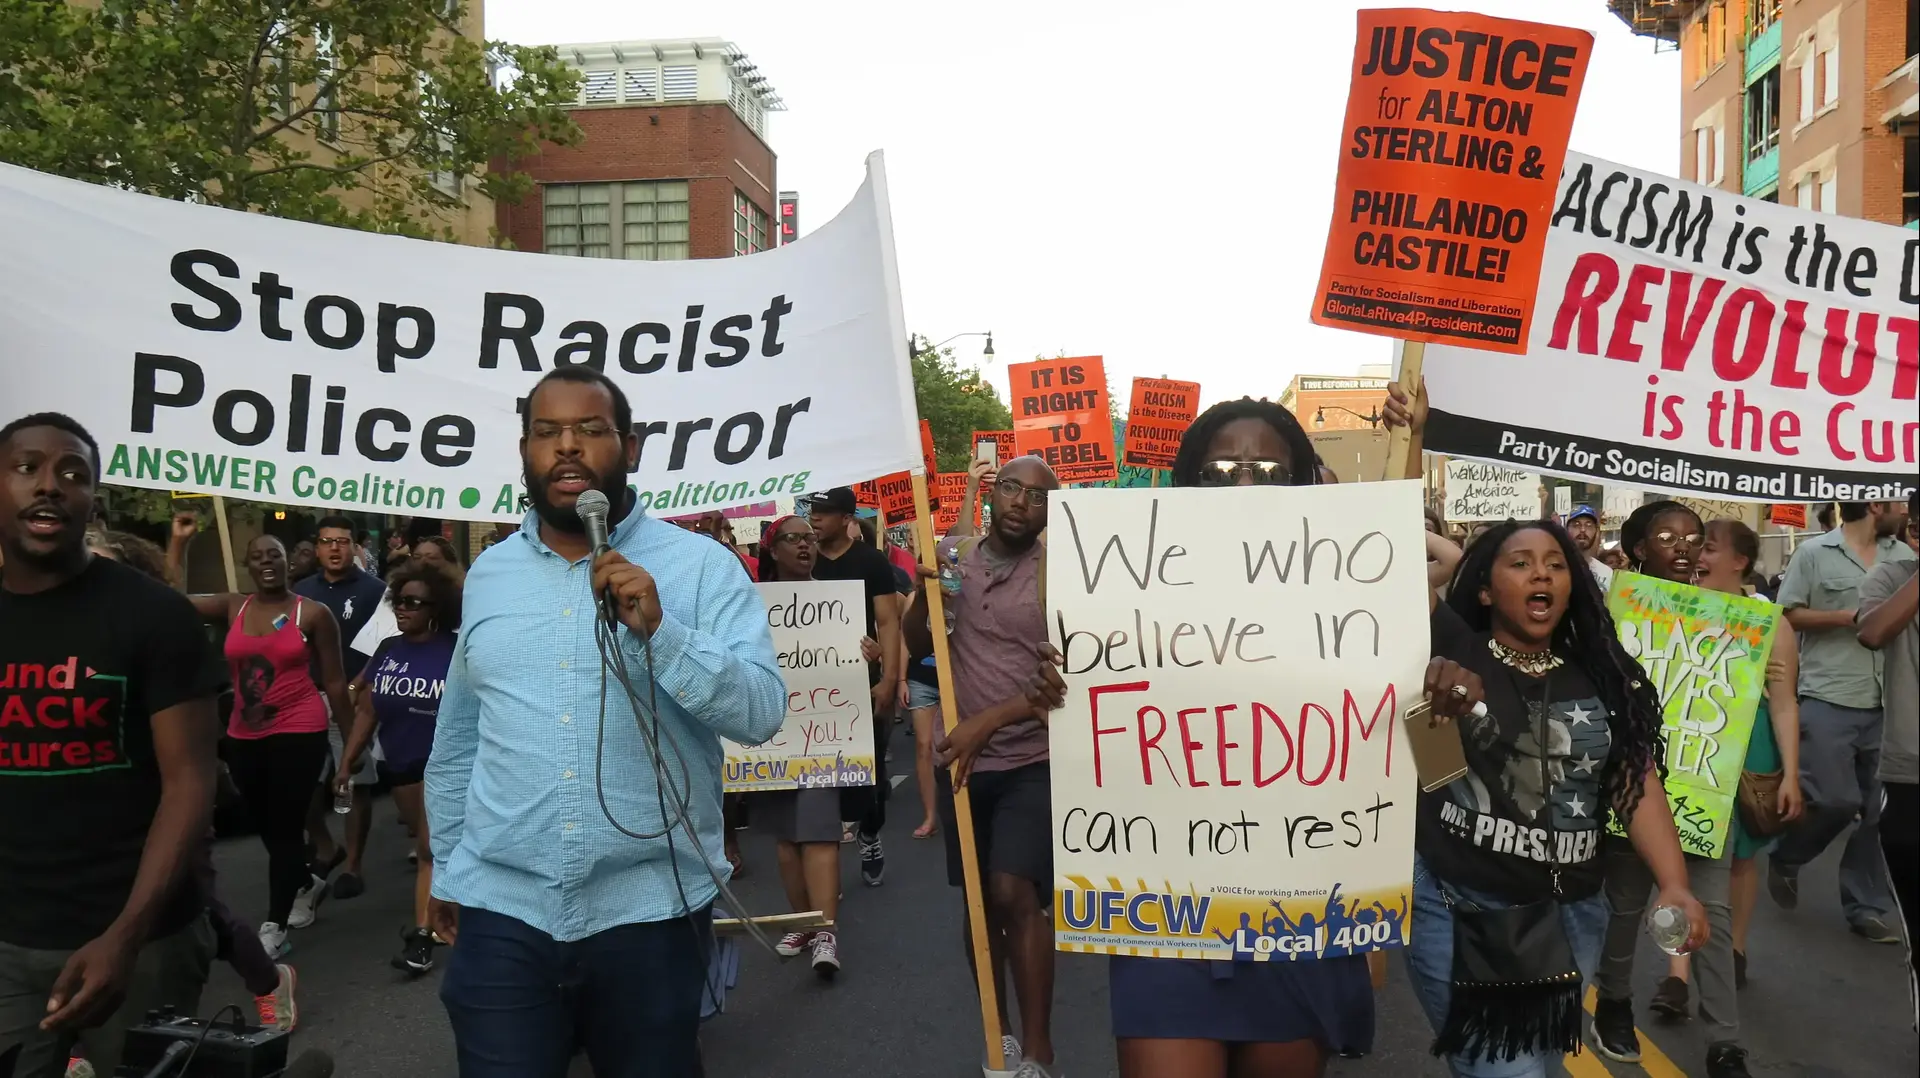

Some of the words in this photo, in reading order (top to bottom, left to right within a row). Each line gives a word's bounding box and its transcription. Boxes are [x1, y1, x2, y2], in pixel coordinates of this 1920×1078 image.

[1361, 26, 1577, 97] JUSTICE
[1378, 87, 1411, 119] for
[1416, 89, 1533, 136] ALTON
[1351, 126, 1514, 174] STERLING
[1518, 145, 1545, 180] &
[1351, 190, 1528, 244] PHILANDO
[1552, 162, 1713, 263] ACISM
[1722, 204, 1769, 275] is
[1785, 223, 1877, 297] the
[1354, 232, 1510, 283] CASTILE!
[170, 249, 435, 373] Stop
[478, 292, 793, 374] Racist
[1326, 300, 1516, 338] GloriaLaRiva4President.com
[1331, 281, 1357, 296] Party
[1359, 285, 1374, 297] for
[1376, 287, 1435, 305] Socialism
[1437, 296, 1459, 308] and
[1460, 297, 1521, 316] Liberation
[1031, 368, 1054, 389] IT
[1060, 365, 1085, 385] IS
[1144, 391, 1186, 408] RACISM
[130, 352, 476, 468] Police
[516, 397, 811, 474] rror
[1022, 390, 1098, 416] RIGHT
[1133, 406, 1139, 415] is
[1142, 407, 1156, 417] the
[1642, 374, 1685, 441] is
[1707, 388, 1800, 456] the
[1048, 422, 1081, 443] TO
[1136, 441, 1142, 450] is
[1145, 441, 1159, 452] the
[107, 443, 276, 495] ANSWER
[292, 465, 445, 509] Coalition
[938, 476, 968, 487] USTIC
[1499, 430, 1560, 466] Party
[1565, 442, 1601, 470] for
[1604, 449, 1729, 490] Socialism
[1735, 472, 1786, 496] and
[890, 499, 896, 508] is
[899, 495, 912, 506] the
[1061, 498, 1194, 595] We
[1242, 515, 1394, 586] who
[768, 592, 850, 629] edom,
[776, 641, 860, 669] edom...
[1055, 608, 1277, 674] believe
[1314, 608, 1379, 660] in
[1620, 618, 1748, 698] BLACK
[0, 694, 110, 729] ACK
[800, 704, 860, 756] you?
[1088, 680, 1396, 789] FREEDOM
[725, 760, 788, 783] UFCW
[799, 771, 835, 785] Local
[840, 771, 867, 784] 400
[1661, 724, 1720, 788] TER
[1061, 807, 1158, 856] can
[1188, 809, 1260, 857] not
[1285, 791, 1394, 858] rest
[1440, 800, 1470, 829] MR.
[1473, 814, 1598, 864] PRESDEN
[1063, 889, 1212, 935] UFCW
[1216, 886, 1242, 895] VOICE
[1244, 887, 1256, 895] for
[1258, 889, 1292, 898] working
[1294, 888, 1327, 897] America
[1063, 934, 1087, 942] United
[1088, 935, 1106, 943] Food
[1108, 936, 1121, 944] and
[1122, 938, 1165, 947] Commercial
[1167, 939, 1198, 948] Workers
[1199, 941, 1221, 949] Union
[1236, 926, 1323, 953] Local
[1333, 921, 1391, 948] 400
